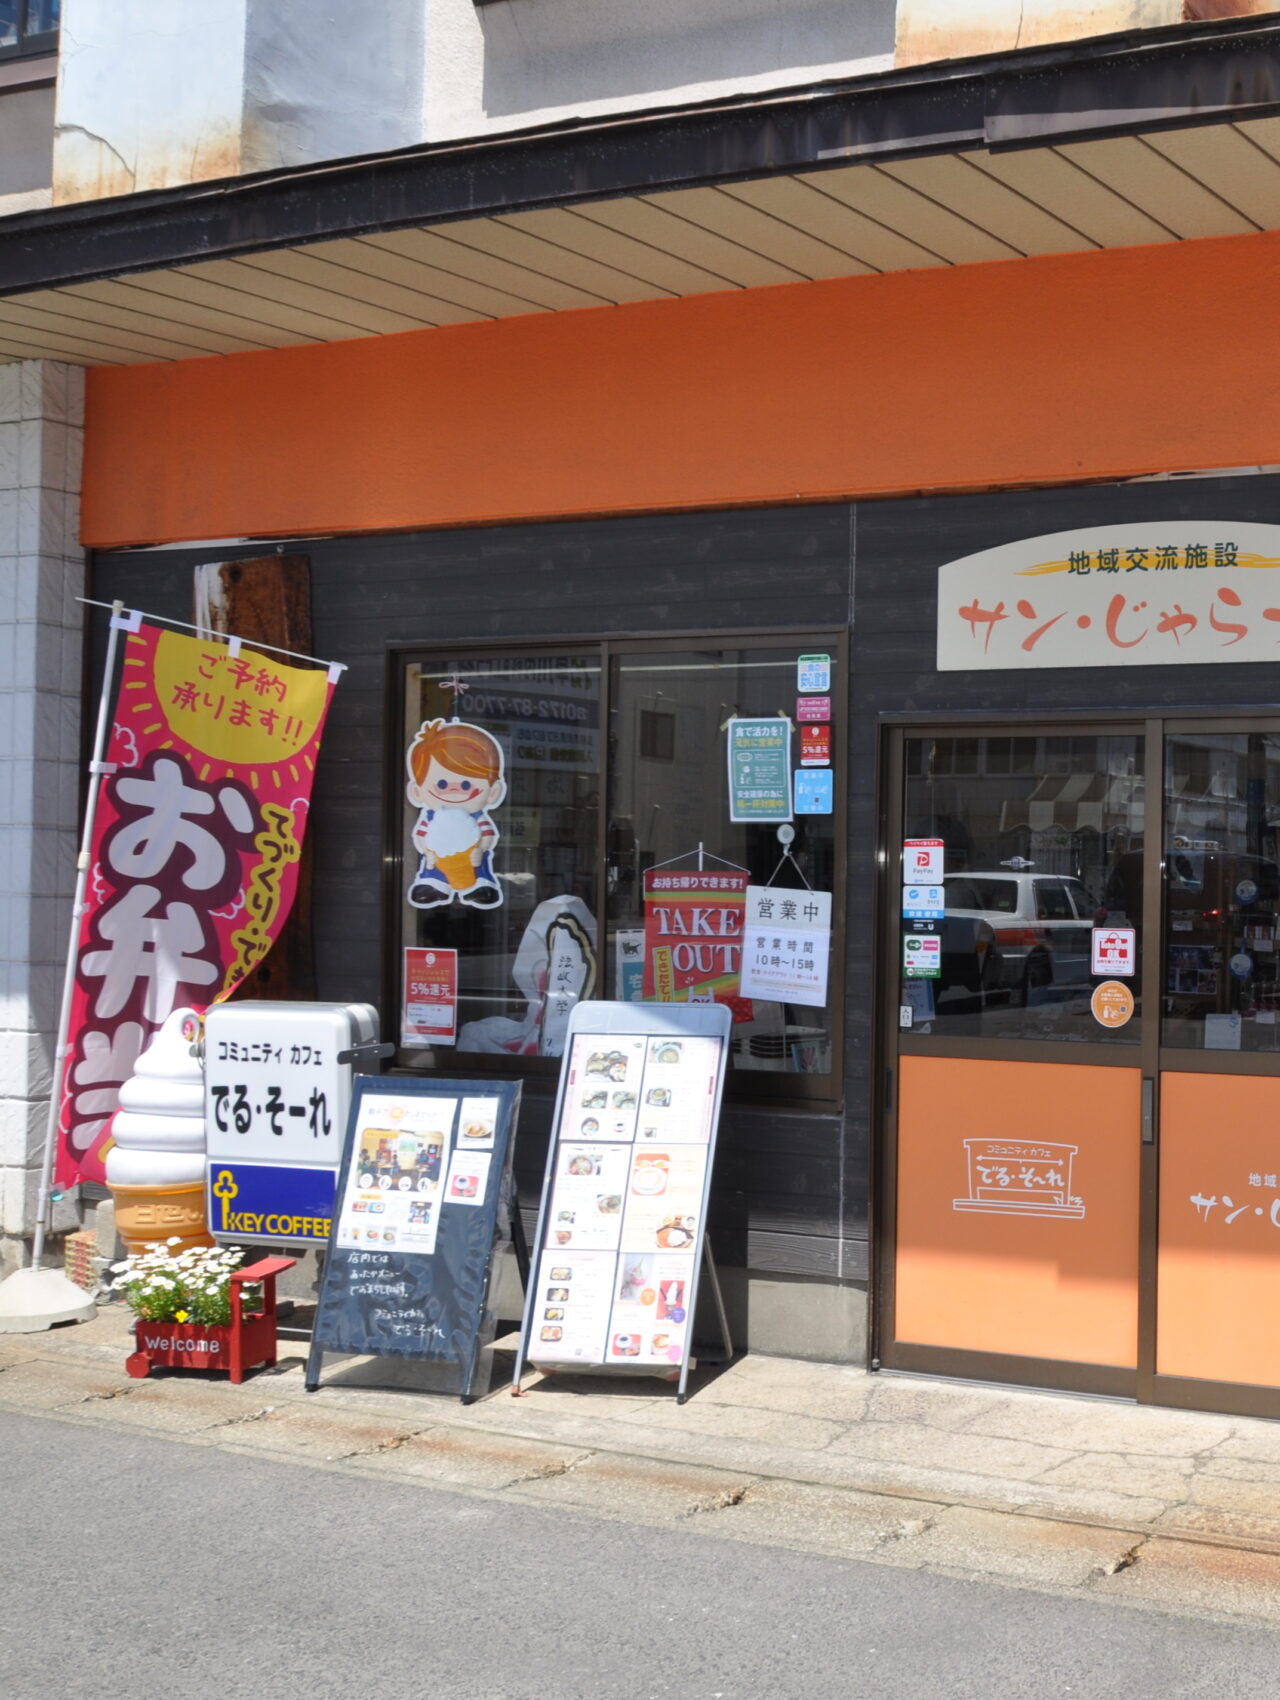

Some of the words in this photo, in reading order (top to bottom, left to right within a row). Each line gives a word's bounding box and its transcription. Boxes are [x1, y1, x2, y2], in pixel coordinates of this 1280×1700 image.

[1068, 542, 1239, 575] 地域交流施設
[198, 653, 288, 704] ご予約
[170, 685, 303, 746] 承ります!!
[651, 876, 743, 889] お持ち帰りできます!
[652, 907, 741, 937] TAKE
[757, 897, 819, 923] 営業中
[672, 943, 741, 973] OUT
[756, 936, 814, 954] 営業時間
[218, 1042, 283, 1063] コミュニティ
[290, 1044, 323, 1065] カフェ
[211, 1084, 331, 1138] でる・そーれ
[986, 1145, 1026, 1156] コミュニティ
[227, 1211, 264, 1231] KEY
[265, 1214, 332, 1237] COFFEE
[144, 1335, 220, 1353] Welcome
